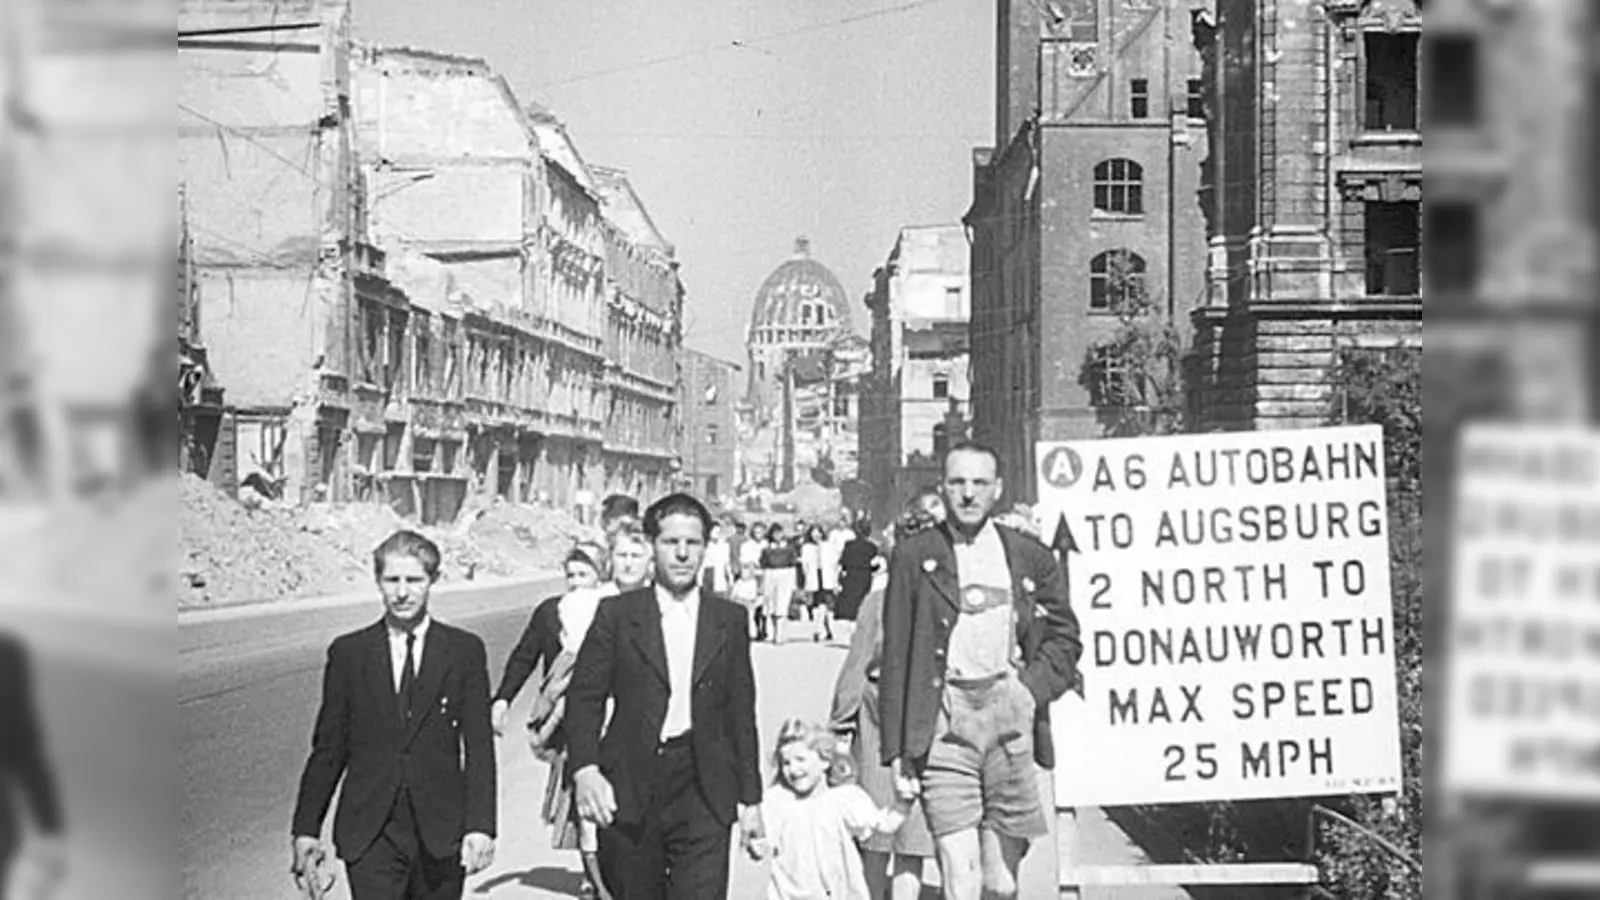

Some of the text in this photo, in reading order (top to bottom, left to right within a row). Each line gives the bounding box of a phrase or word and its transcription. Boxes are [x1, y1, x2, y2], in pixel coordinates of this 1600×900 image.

[1049, 441, 1378, 491] A A6 AUTOBAHN
[1085, 500, 1382, 551] TO AUGSBURG
[1090, 560, 1365, 609] 2 NORTH TO
[1094, 617, 1385, 667] DONAUWORTH
[1109, 677, 1373, 725] MAX SPEED
[1164, 737, 1333, 781] 25 MPH
